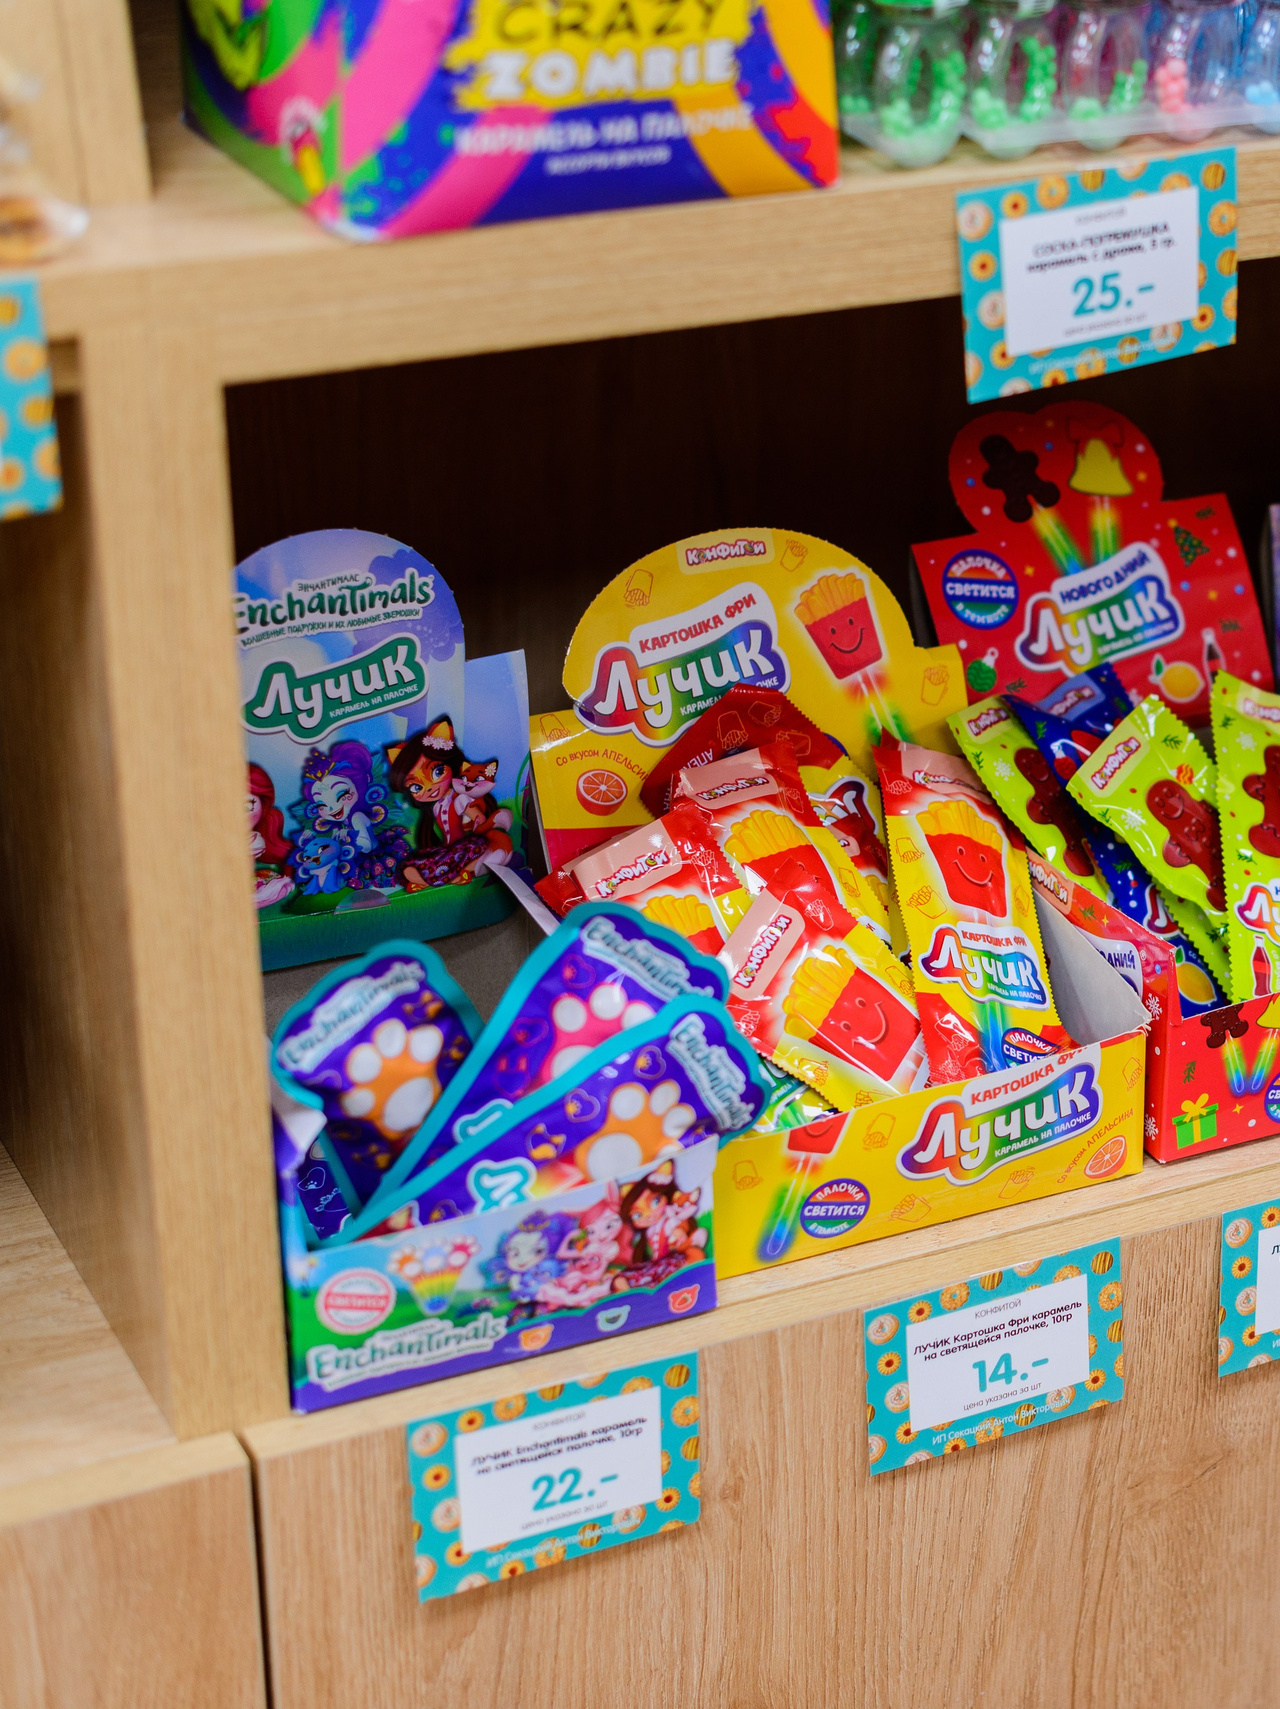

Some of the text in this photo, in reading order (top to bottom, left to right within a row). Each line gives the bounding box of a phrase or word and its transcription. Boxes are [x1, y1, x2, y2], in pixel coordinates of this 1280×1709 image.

[483, 38, 738, 100] ZOMBIE
[1072, 272, 1154, 317] 25.-
[298, 573, 360, 592] ЭНЧАНТИМАЛС
[1060, 550, 1151, 604] НОВОГОДНИЙ
[241, 608, 421, 647] ВОЛШЕБНЫЕ ПОДРУЖКИ И ИХ ЛЮБИМЫЕ ЗВЕРЮШКИ
[639, 594, 757, 653] КАРТОШКА ФРИ
[1029, 581, 1171, 665] Лучик
[253, 645, 416, 729] Лучик
[329, 684, 419, 718] КАРАМЕЛЬ НА ПАЛОЧКЕ
[594, 629, 775, 728] Лучик
[556, 748, 649, 782] Со вкусом АПЕЛЬСИ
[962, 930, 1027, 947] КАРТОШКА ФРИ
[929, 935, 1040, 991] Лучик
[1003, 1044, 1043, 1063] СВЕТИ
[1010, 1033, 1052, 1052] ПАЛОЧКА
[970, 1065, 1055, 1106] КАРТОШКА
[913, 1071, 1090, 1171] Лучик
[994, 1111, 1091, 1158] КАРАМЕЛЬ НА ПАЛОЧКЕ
[1056, 1107, 1135, 1184] Со вкусом АПЕЛЬСИНА
[804, 1205, 865, 1216] СВЕТИТСЯ
[816, 1183, 864, 1201] ПАЛОЧКА
[913, 1301, 1082, 1356] ЛУЧИК Картошка Фри карамель
[974, 1298, 1022, 1319] КОНФИТОЙ
[315, 1319, 502, 1379] Enchantimals
[924, 1313, 1073, 1362] на светящейся палочке, 10гр
[972, 1352, 1049, 1393] 14.-
[963, 1382, 1042, 1412] цена указана за шт
[471, 1416, 648, 1466] ЛУЧИК Enchantimals карамель
[932, 1398, 1071, 1445] ИП Секацкий Антон Викторович
[476, 1466, 492, 1475] на
[494, 1447, 565, 1472] светящейся
[620, 1427, 643, 1441] 10гр
[532, 1467, 618, 1512] 22.-
